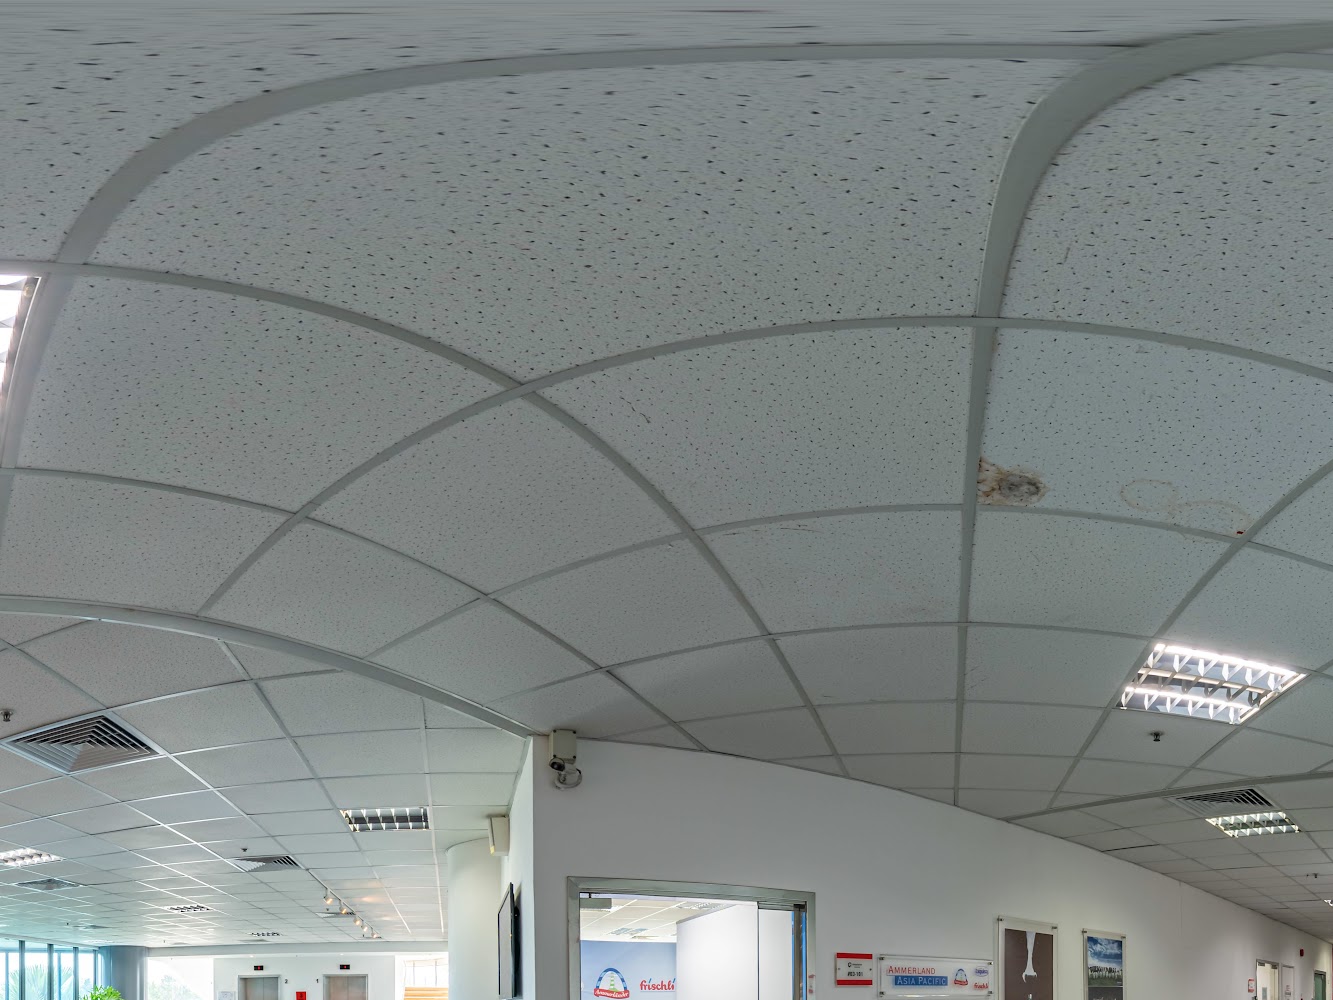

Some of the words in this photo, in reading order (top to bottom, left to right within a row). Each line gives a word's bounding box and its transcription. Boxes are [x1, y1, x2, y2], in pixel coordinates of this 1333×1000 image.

[888, 965, 936, 975] AMMERLAND
[897, 976, 916, 985] ASIA
[918, 976, 946, 985] PACIFIC
